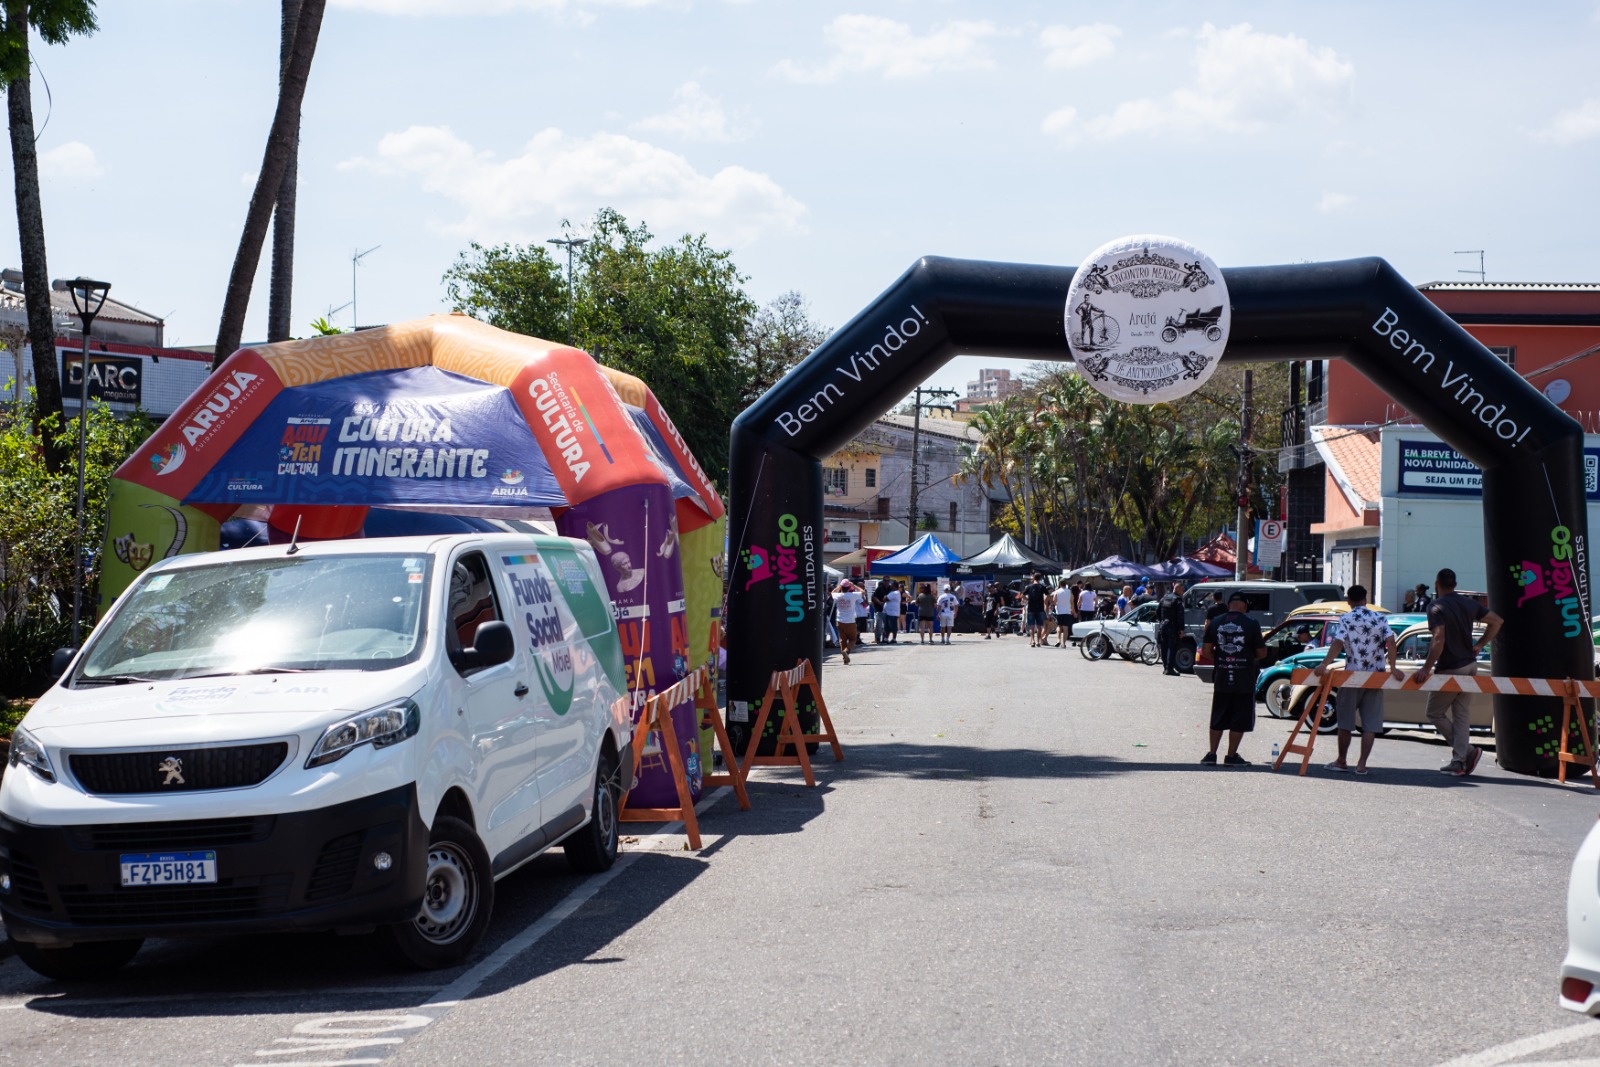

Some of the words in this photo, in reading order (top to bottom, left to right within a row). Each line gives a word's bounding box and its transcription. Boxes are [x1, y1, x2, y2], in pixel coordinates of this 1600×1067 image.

[1110, 267, 1150, 286] ENCONTRO
[1151, 267, 1182, 284] MENSAL
[1129, 311, 1157, 328] Arujá
[69, 361, 138, 390] DARC
[774, 382, 845, 437] Bem
[836, 304, 930, 382] Vindo!
[1115, 362, 1127, 376] DE
[1371, 306, 1436, 374] Bem
[1441, 361, 1532, 448] Vindo!
[104, 390, 137, 399] magazine
[182, 369, 258, 447] ARUJÁ
[547, 371, 577, 419] Secretaria
[572, 418, 584, 433] de
[195, 420, 226, 452] CUIDANDO
[226, 405, 239, 419] DAS
[238, 378, 265, 405] PESSOAS
[338, 416, 453, 443] CULTURA
[281, 425, 329, 448] AQUI
[528, 378, 591, 484] CULTURA
[332, 447, 489, 478] ITINERANTE
[657, 404, 716, 501] CULTURA
[1404, 448, 1419, 458] EM
[1421, 449, 1451, 459] BREVE
[1404, 459, 1433, 468] NOVA
[277, 462, 319, 476] CULTURA
[1425, 475, 1447, 484] SEJA
[1449, 476, 1465, 485] UM
[491, 486, 529, 496] ARUJÁ
[1267, 524, 1276, 536] E
[776, 513, 805, 623] universo
[803, 525, 818, 610] UTILIDADES
[1550, 525, 1581, 638] universo
[1575, 535, 1590, 622] UTILIDADES
[508, 569, 552, 607] Fundo
[526, 605, 564, 648] Social
[551, 648, 573, 674] Móvel
[624, 657, 656, 689] EM
[130, 862, 206, 882] FZP5H81
